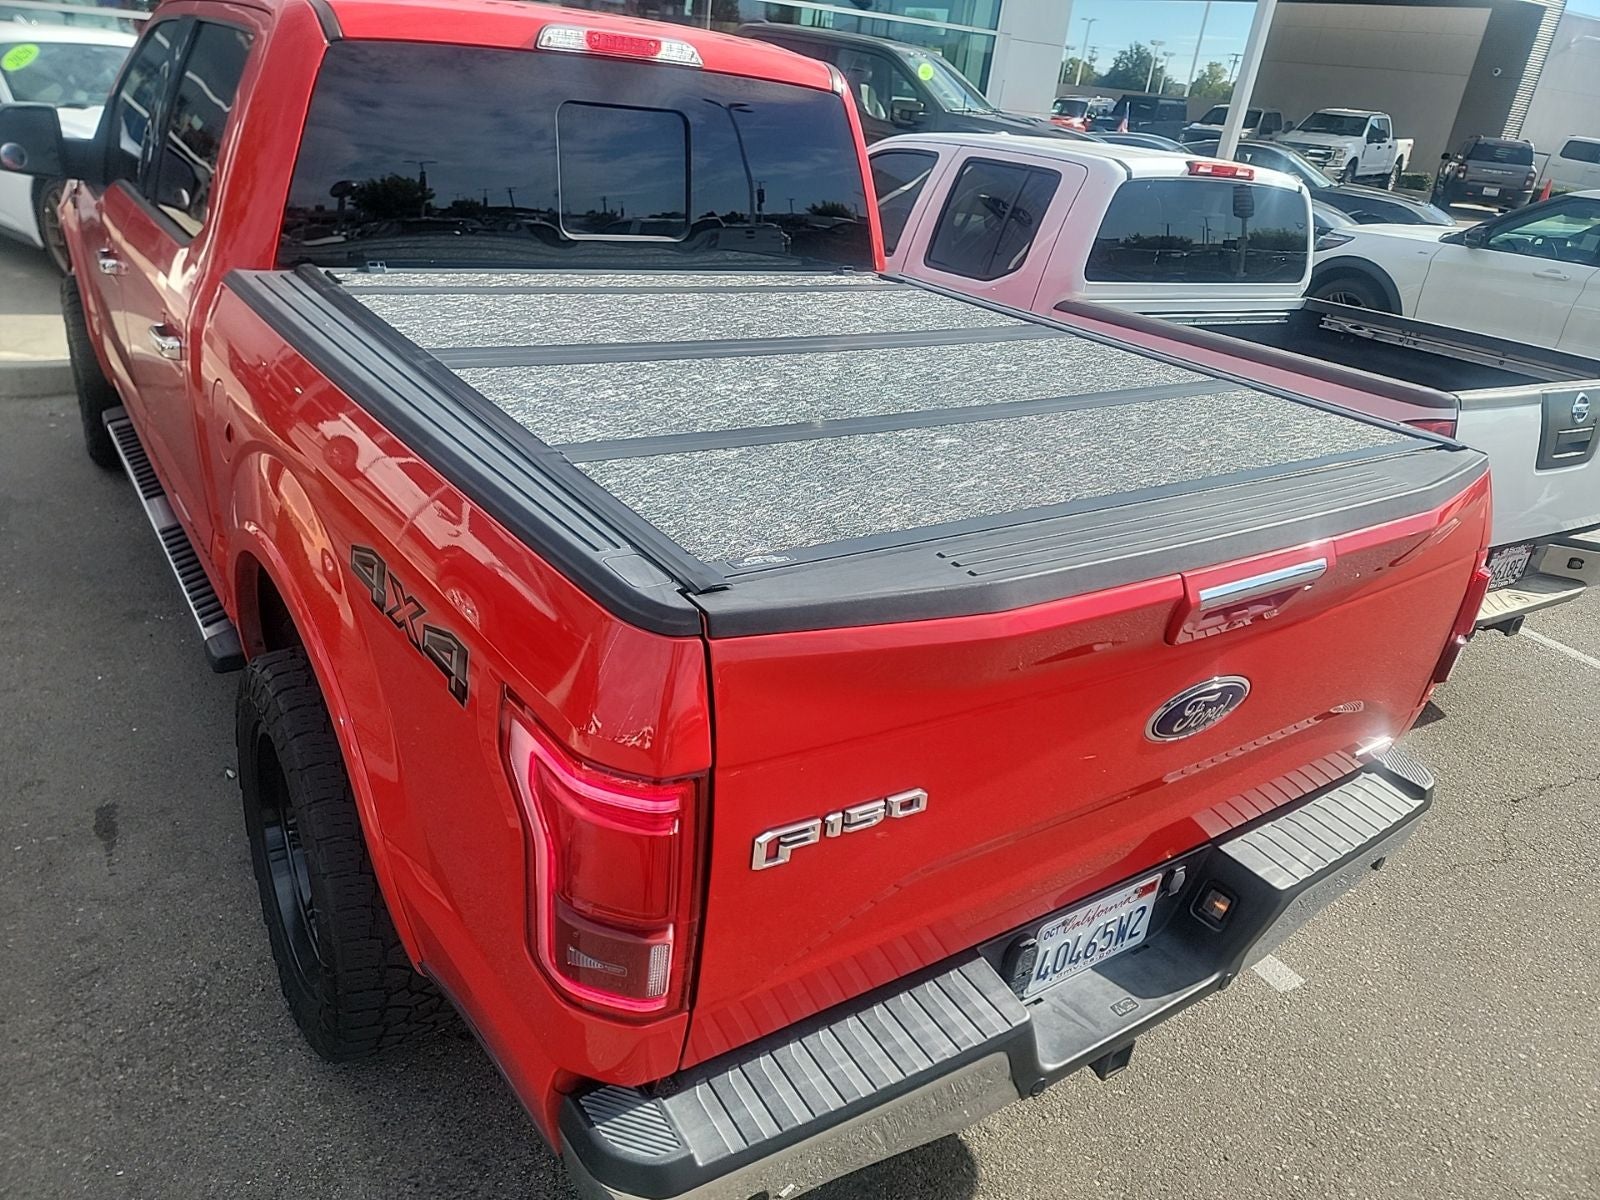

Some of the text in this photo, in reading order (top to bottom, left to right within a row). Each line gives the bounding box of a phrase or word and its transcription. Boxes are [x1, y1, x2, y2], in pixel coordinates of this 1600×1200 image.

[1172, 692, 1233, 733] Ford
[1043, 925, 1060, 941] OCT
[1063, 894, 1138, 934] California
[1035, 905, 1147, 981] 40465W2
